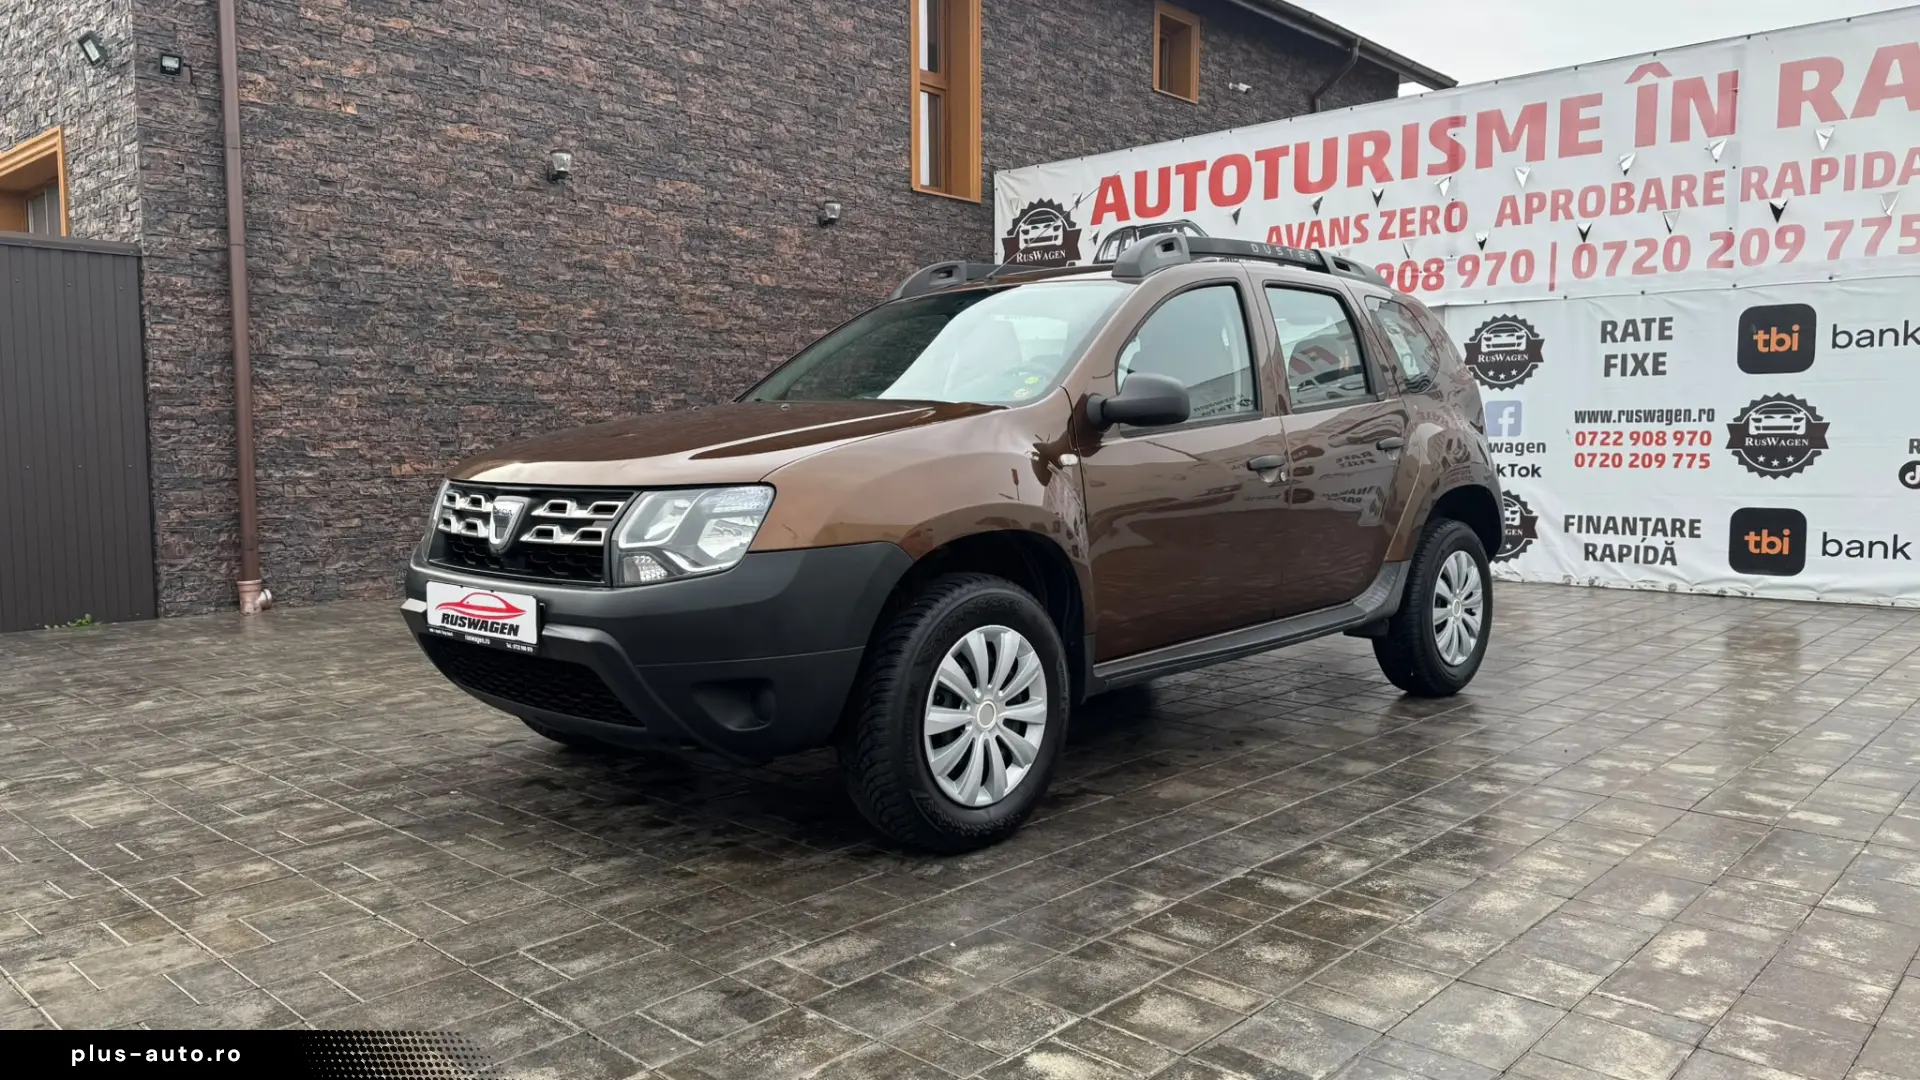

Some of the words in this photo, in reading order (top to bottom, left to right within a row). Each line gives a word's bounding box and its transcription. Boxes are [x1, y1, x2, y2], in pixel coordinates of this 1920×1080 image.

[1091, 92, 1604, 226] AUTOTURISME
[1626, 61, 1739, 148] ÎN
[1266, 213, 1369, 250] AVANS
[1378, 201, 1468, 241] ZERO
[1494, 169, 1726, 228] APROBARE
[1251, 243, 1319, 263] DUSTER
[1457, 248, 1535, 288] 970
[1571, 235, 1691, 279] 0720
[1706, 224, 1806, 269] 209
[1824, 214, 1920, 260] 775
[1600, 316, 1674, 344] RATE
[1753, 324, 1799, 353] tbi
[1831, 319, 1920, 349] bank
[1603, 352, 1667, 378] FIXE
[1574, 408, 1715, 426] www.ruswagen.ro
[1574, 430, 1624, 447] 0722
[1628, 430, 1668, 447] 908
[1672, 429, 1713, 447] 970
[1574, 452, 1624, 469] 0720
[1627, 452, 1667, 470] 209
[1672, 452, 1711, 470] 775
[1744, 528, 1791, 556] tbi
[1821, 531, 1912, 561] bank
[441, 613, 520, 637] RUSWAGEN
